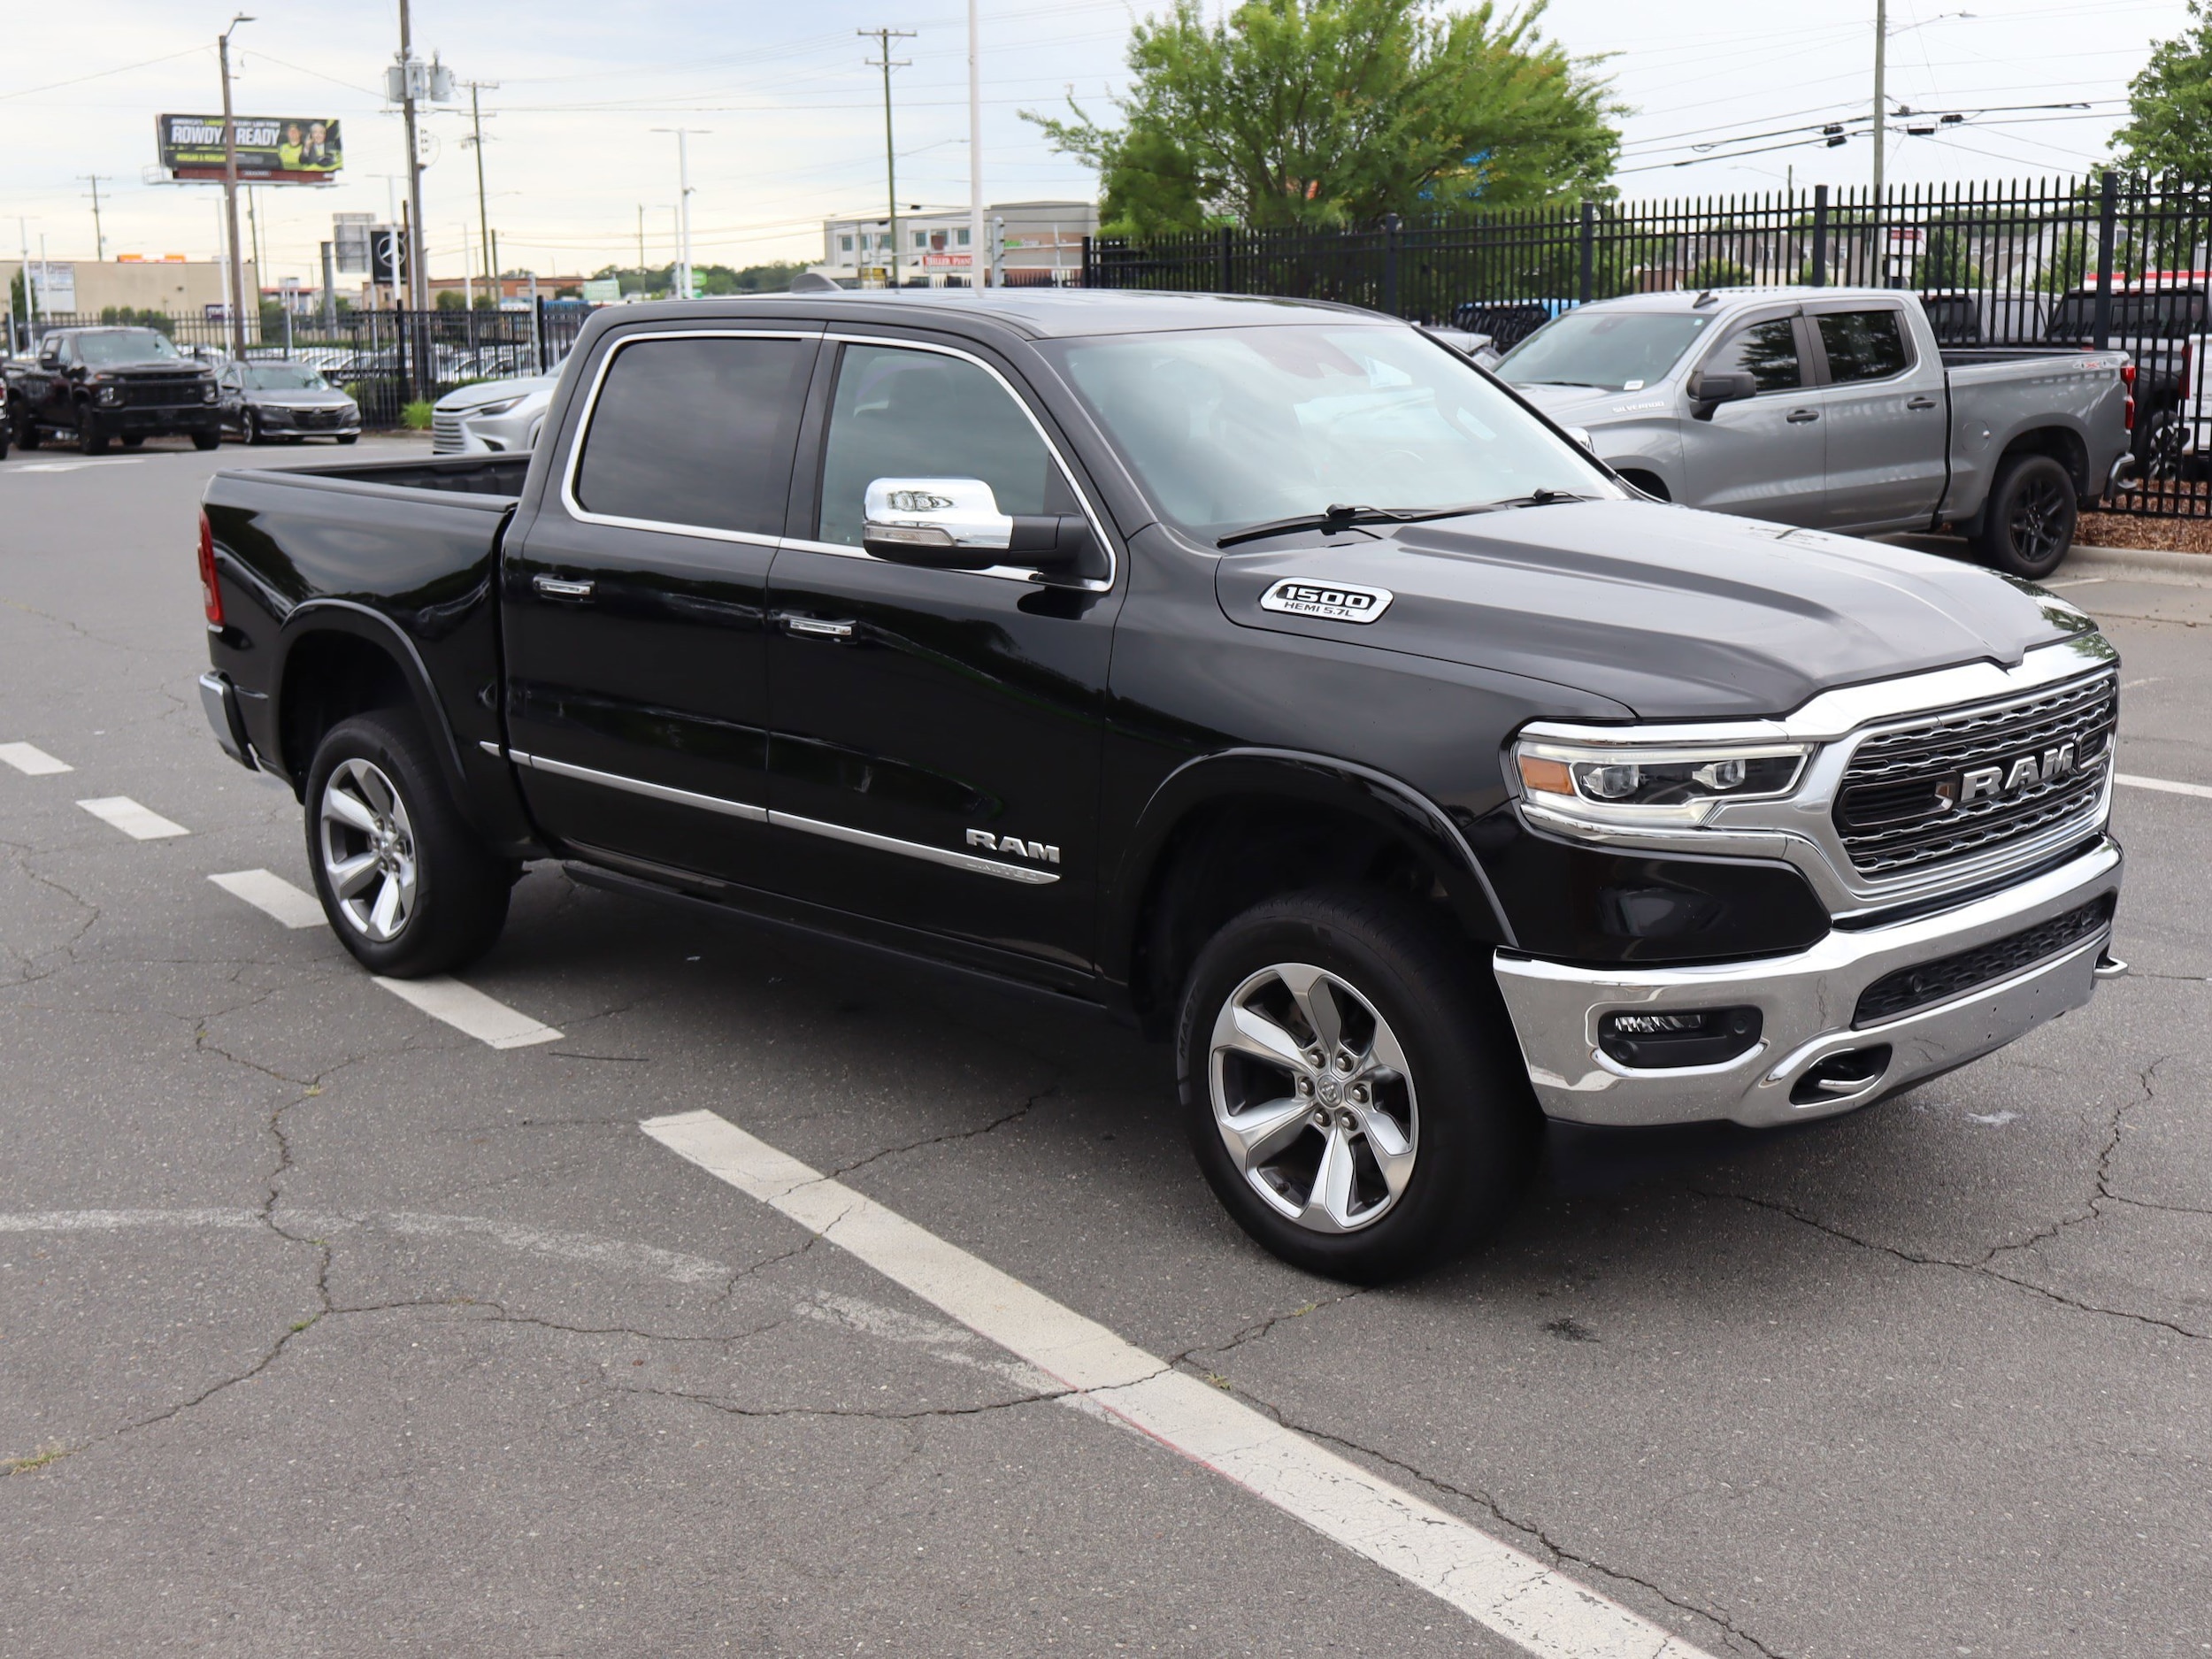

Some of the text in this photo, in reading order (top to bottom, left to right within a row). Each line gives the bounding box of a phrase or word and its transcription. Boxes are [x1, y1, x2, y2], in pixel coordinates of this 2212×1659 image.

[172, 126, 222, 143] ROWDY
[235, 128, 280, 146] READY
[1612, 401, 1664, 413] SILVERADO
[1286, 586, 1371, 609] 1500
[1284, 601, 1354, 617] HEMI 5.7L
[1961, 741, 2075, 802] RAM
[965, 827, 1060, 864] RAM
